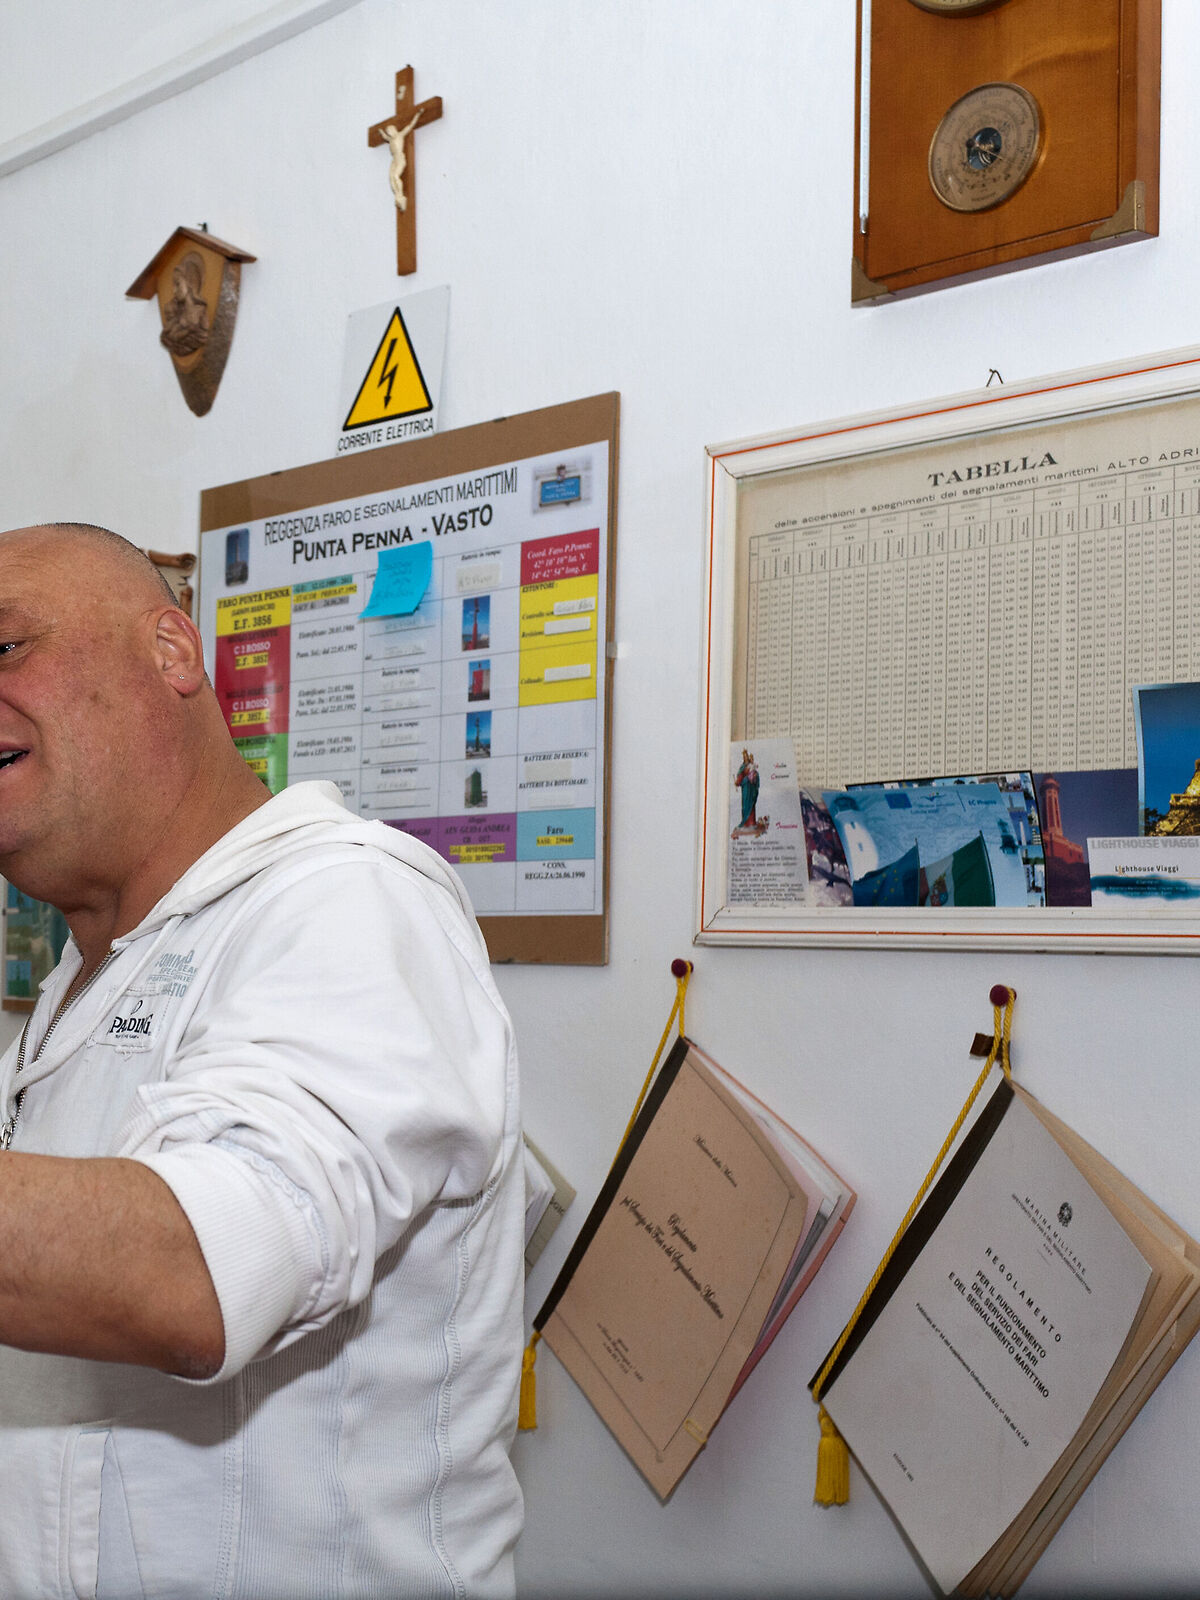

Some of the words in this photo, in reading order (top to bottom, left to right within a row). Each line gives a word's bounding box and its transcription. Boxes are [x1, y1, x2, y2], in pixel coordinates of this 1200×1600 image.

[338, 428, 383, 452] CORRENTE
[386, 418, 434, 440] ELETTRICA
[927, 452, 1059, 488] TABELLA
[264, 516, 321, 546] REGGENZA
[322, 508, 352, 530] FARO
[354, 506, 362, 522] E
[362, 486, 454, 518] SEGNALAMENTI
[456, 466, 518, 501] MARITTIMI
[774, 516, 798, 530] delle
[802, 508, 856, 525] accensioni
[871, 493, 936, 514] spegnimenti
[940, 490, 957, 500] dei
[962, 476, 1040, 498] segnalamenti
[1044, 464, 1100, 482] marittimi
[1107, 454, 1150, 472] ALTO
[218, 596, 238, 609] FARO
[238, 592, 263, 606] PUNTA
[264, 588, 290, 600] PENNA
[246, 641, 271, 653] ROSSO
[246, 698, 270, 710] ROSSO
[546, 826, 564, 834] Faro
[1091, 838, 1160, 849] LIGHTHOUSE
[1161, 838, 1200, 848] VIAGGI
[1114, 865, 1154, 874] Lighthouse
[1156, 865, 1179, 874] Viaggi
[1024, 1196, 1052, 1230] MARINA
[1053, 1231, 1086, 1276] MILITARE
[984, 1247, 1062, 1342] REGOLAMENTO
[971, 1282, 984, 1300] DEL
[984, 1298, 1012, 1334] SERVIZIO
[1011, 1332, 1024, 1348] DEI
[1022, 1346, 1038, 1368] FARI
[976, 1270, 990, 1288] PER
[988, 1286, 996, 1296] IL
[995, 1294, 1046, 1359] FUNZIONAMENTO
[948, 1272, 956, 1280] E
[954, 1278, 967, 1296] DEL
[966, 1293, 1015, 1355] SEGNALAMENTO
[1014, 1353, 1050, 1398] MARITTIMO
